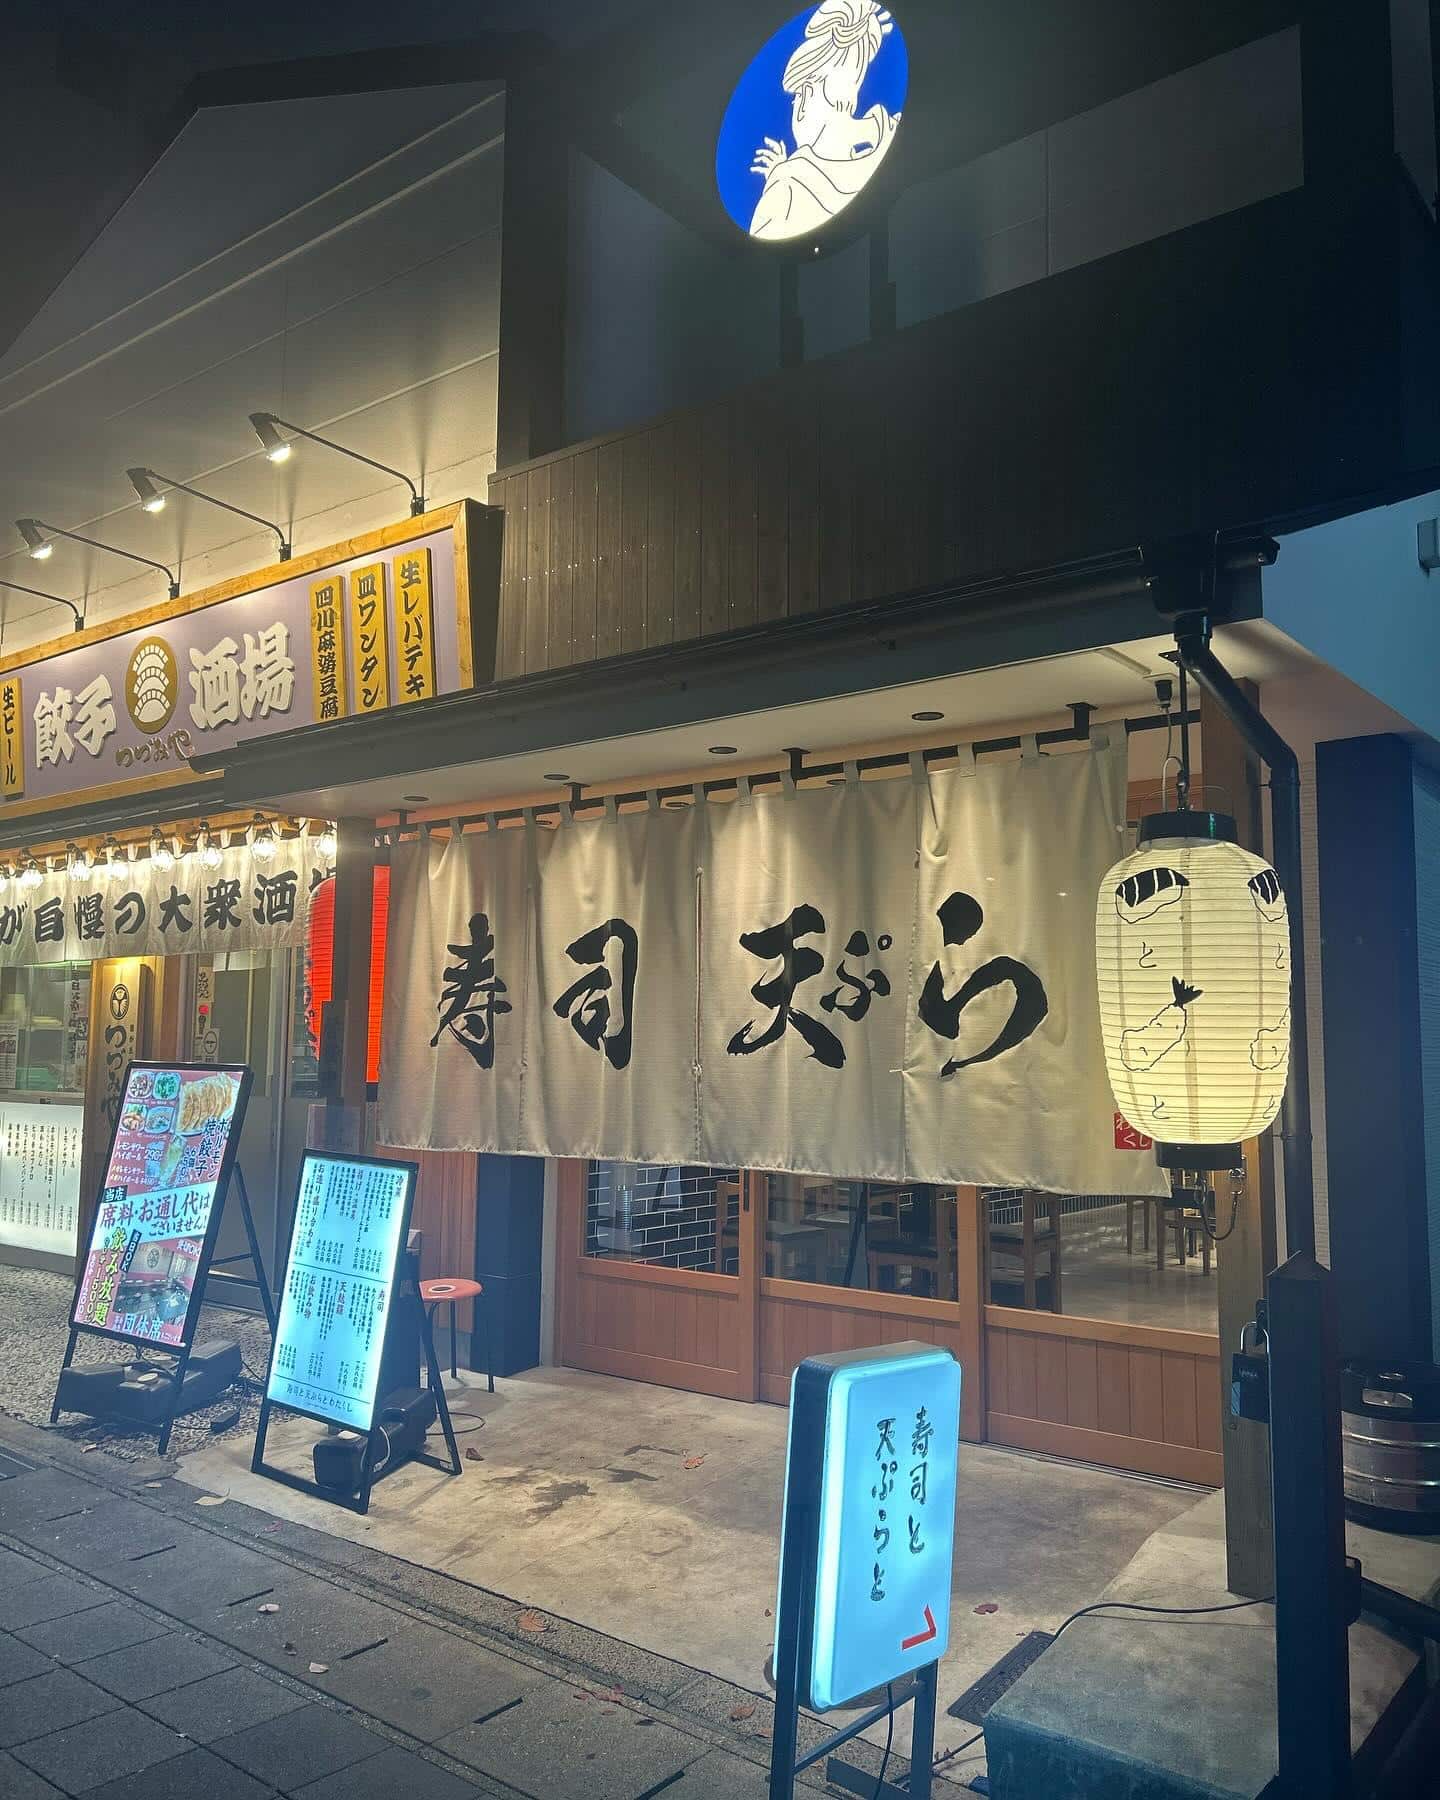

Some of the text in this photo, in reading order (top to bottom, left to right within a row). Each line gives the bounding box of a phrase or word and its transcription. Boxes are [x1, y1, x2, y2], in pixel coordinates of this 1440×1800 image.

[400, 559, 426, 698] 生レバテキ
[3, 685, 17, 786] 生ビール
[33, 620, 296, 769] 餃子 酒場
[0, 868, 337, 946] が自慢の大衆酒
[1138, 942, 1157, 968] と
[1152, 1095, 1170, 1119] と
[104, 1188, 125, 1201] 当店
[95, 1227, 127, 1327] 飲み放題
[869, 1417, 899, 1602] 天ぷらと
[908, 1405, 935, 1554] 寿司と
